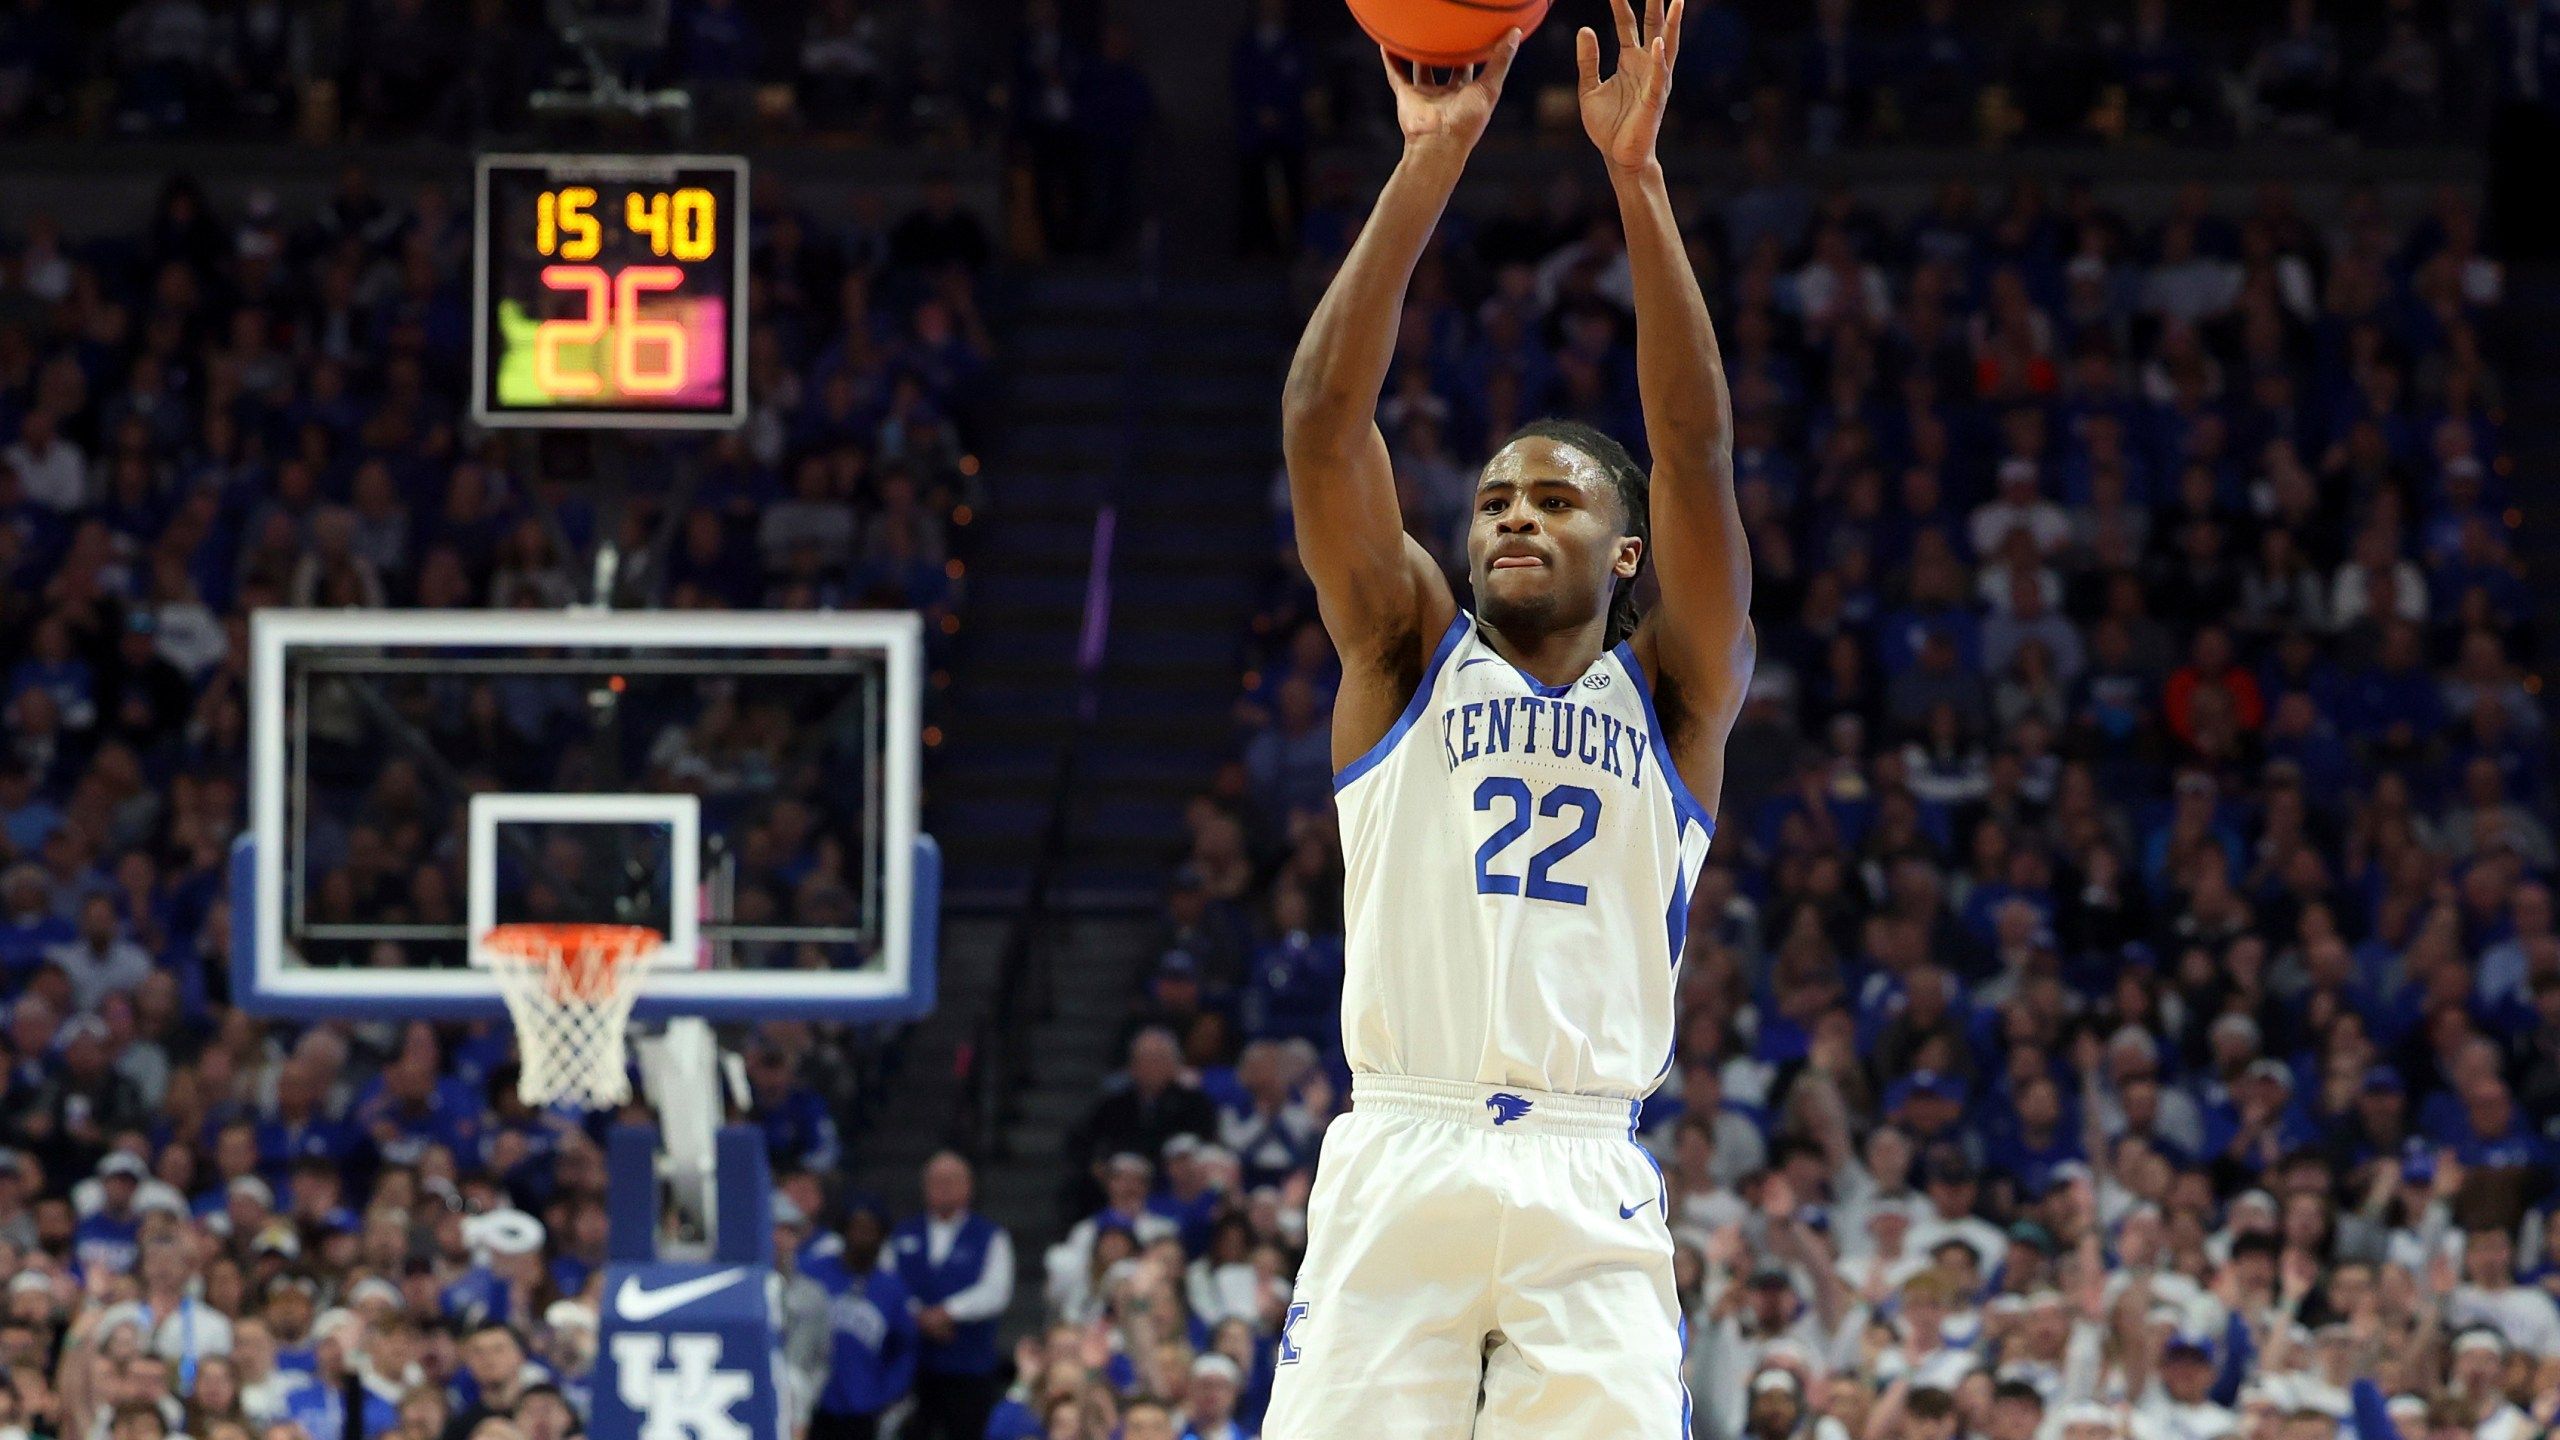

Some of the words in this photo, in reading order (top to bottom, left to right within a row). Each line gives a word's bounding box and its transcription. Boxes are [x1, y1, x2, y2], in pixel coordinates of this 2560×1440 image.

[537, 186, 602, 261] 15
[624, 187, 716, 262] 40
[534, 265, 689, 396] 26
[1583, 674, 1610, 690] SEC
[1442, 696, 1647, 789] KENTUCKY
[1473, 776, 1603, 906] 22
[610, 1331, 754, 1440] UK
